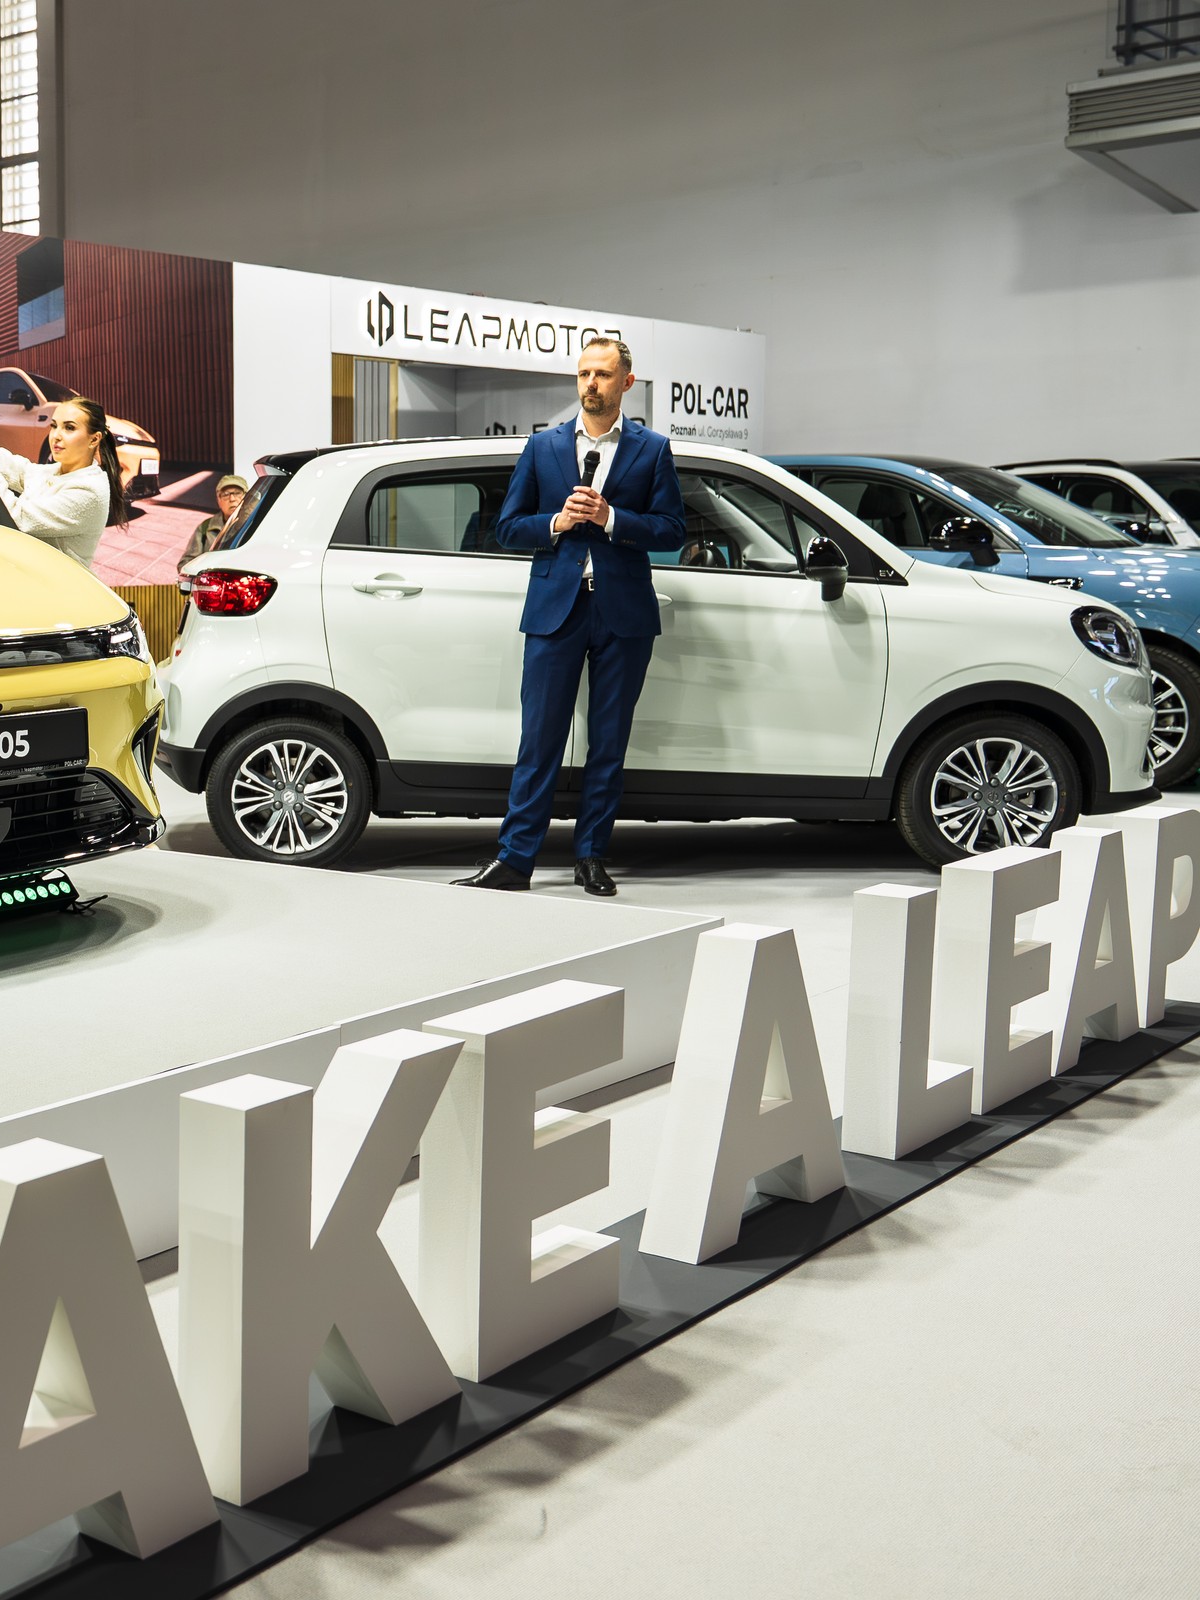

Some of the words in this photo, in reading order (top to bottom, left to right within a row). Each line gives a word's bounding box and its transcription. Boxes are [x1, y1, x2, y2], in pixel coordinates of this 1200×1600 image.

[670, 382, 750, 420] POL-CAR
[670, 423, 697, 437] Poznań
[743, 428, 749, 440] 9
[879, 569, 895, 577] EV
[639, 922, 847, 1265] A
[841, 806, 1200, 1160] LEAP
